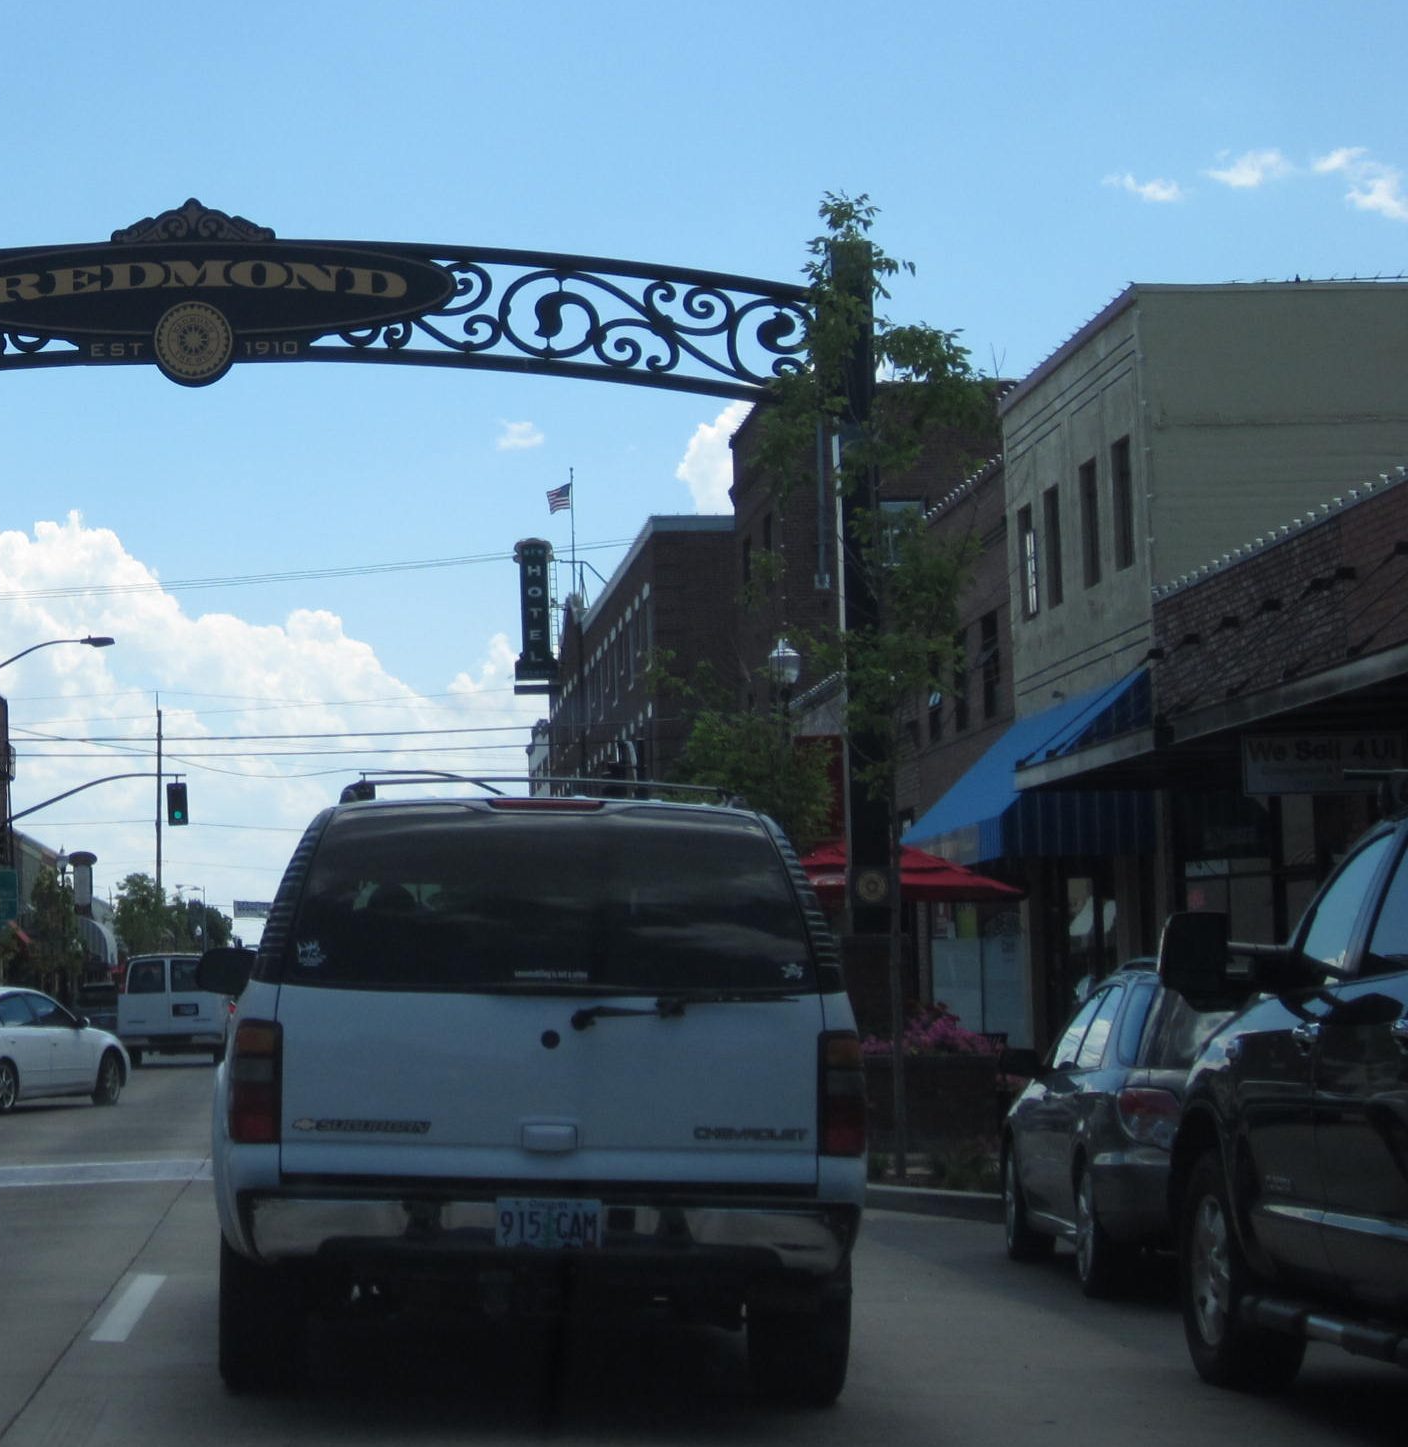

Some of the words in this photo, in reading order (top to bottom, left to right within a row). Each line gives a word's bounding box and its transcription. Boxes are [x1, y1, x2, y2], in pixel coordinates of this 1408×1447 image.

[90, 343, 144, 357] EST
[245, 341, 298, 355] 1910
[527, 564, 544, 662] HOTEL
[1247, 739, 1287, 762] We
[1295, 739, 1342, 761] Sell
[500, 1211, 541, 1240] 915
[557, 1211, 597, 1240] CAM
